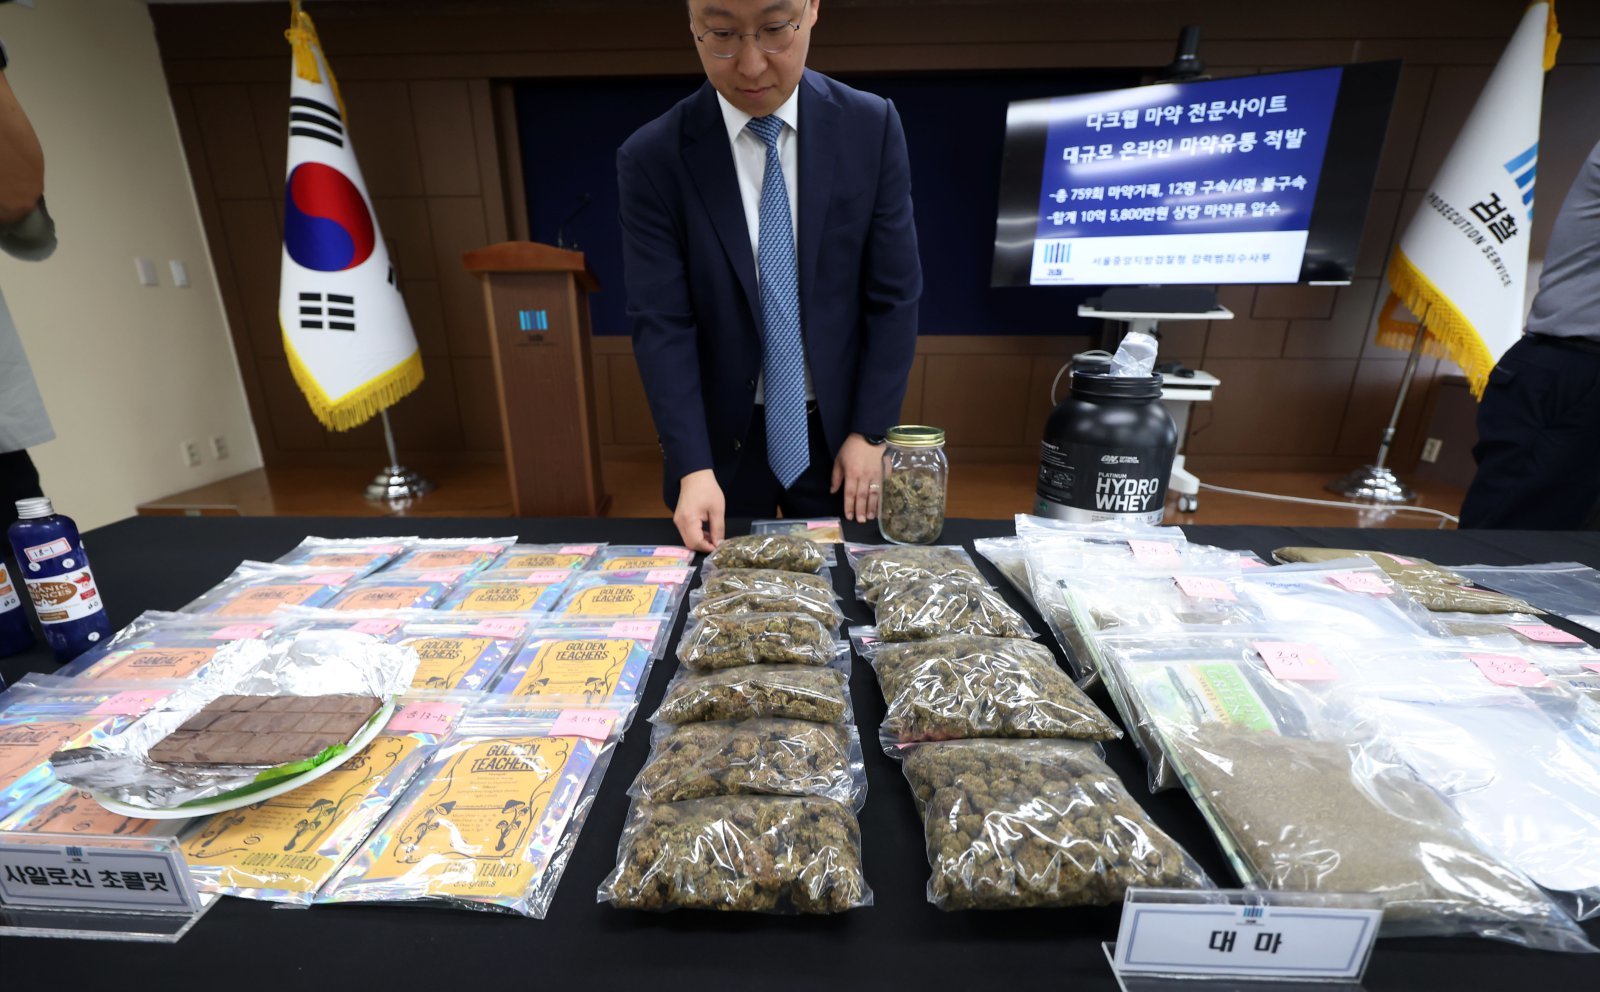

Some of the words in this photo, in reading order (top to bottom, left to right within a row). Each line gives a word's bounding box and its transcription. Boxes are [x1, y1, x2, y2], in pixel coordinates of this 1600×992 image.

[1086, 109, 1139, 131] 다크웹
[1145, 105, 1184, 126] 마약
[1188, 94, 1288, 123] 전문사이트
[1063, 144, 1114, 164] 대규모
[1119, 139, 1173, 161] 온라인
[1179, 132, 1258, 156] 마약유통
[1263, 128, 1307, 150] 적발
[1071, 187, 1104, 200] 759회
[1108, 182, 1163, 200] 마약거래,
[1168, 180, 1196, 196] 12명
[1200, 177, 1257, 195] 구속/4명
[1261, 175, 1308, 192] 불구속
[1081, 208, 1106, 223] 10억
[1110, 206, 1169, 222] 5,800만원
[1173, 204, 1201, 220] 상당
[1204, 202, 1247, 218] 마약류
[1251, 201, 1280, 217] 압수
[1469, 192, 1518, 244] 검찰
[1482, 245, 1512, 287] SERVICE
[1096, 477, 1160, 496] HYDRO
[1095, 493, 1152, 512] WHEY
[591, 594, 635, 602] TEACHERS
[416, 649, 463, 659] ACHERS
[421, 641, 463, 649] GOLDEN
[556, 650, 609, 660] TEACHERS
[566, 642, 607, 650] GOLDEN
[1206, 669, 1242, 717] GREEN
[241, 852, 278, 866] GOLDEN
[277, 855, 322, 871] TEACHERS
[478, 863, 522, 877] TEACHERS
[5, 864, 95, 889] 사일로신
[98, 870, 169, 892] 초콜릿
[1208, 930, 1237, 953] 대
[1253, 932, 1283, 954] 마
